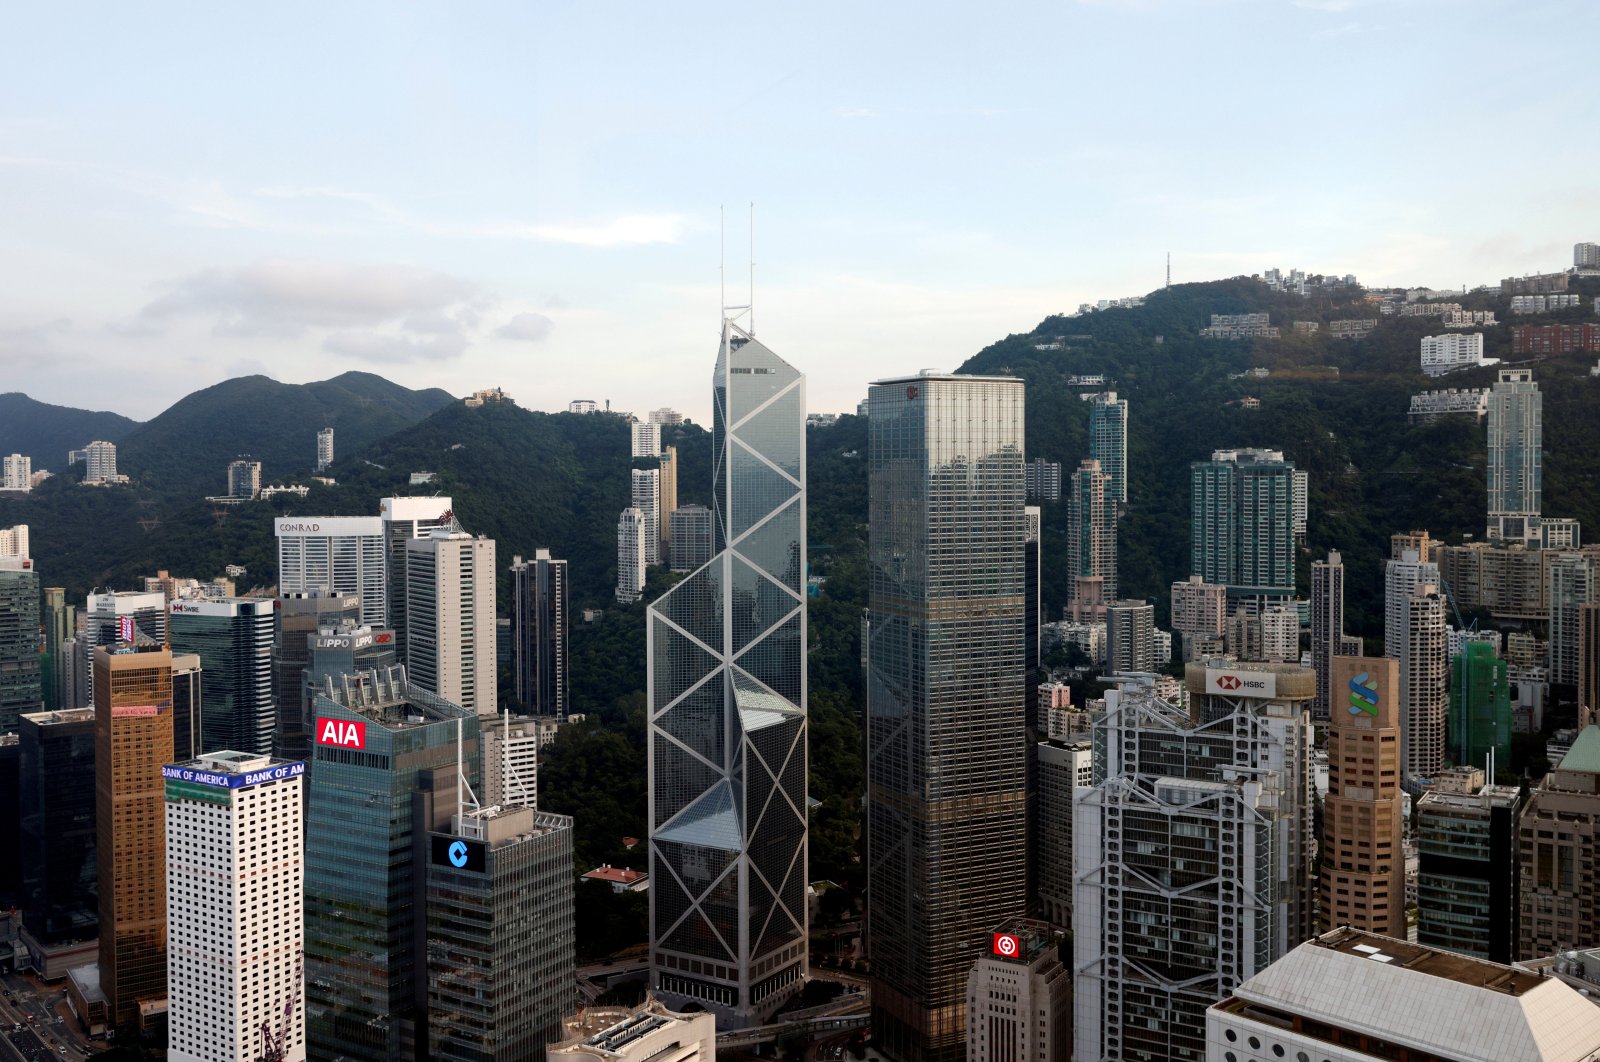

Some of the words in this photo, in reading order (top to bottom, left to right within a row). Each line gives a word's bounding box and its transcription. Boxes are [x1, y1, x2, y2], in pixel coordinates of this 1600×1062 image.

[280, 524, 319, 532] CONRAD
[344, 597, 358, 608] LIPPO
[317, 639, 349, 648] LIPPO
[356, 636, 372, 647] LIPPO
[322, 721, 359, 746] AIA
[162, 766, 181, 778] BANK
[183, 771, 193, 780] OF
[195, 773, 229, 786] AMERICA
[246, 771, 272, 784] BANK
[275, 767, 288, 778] OF
